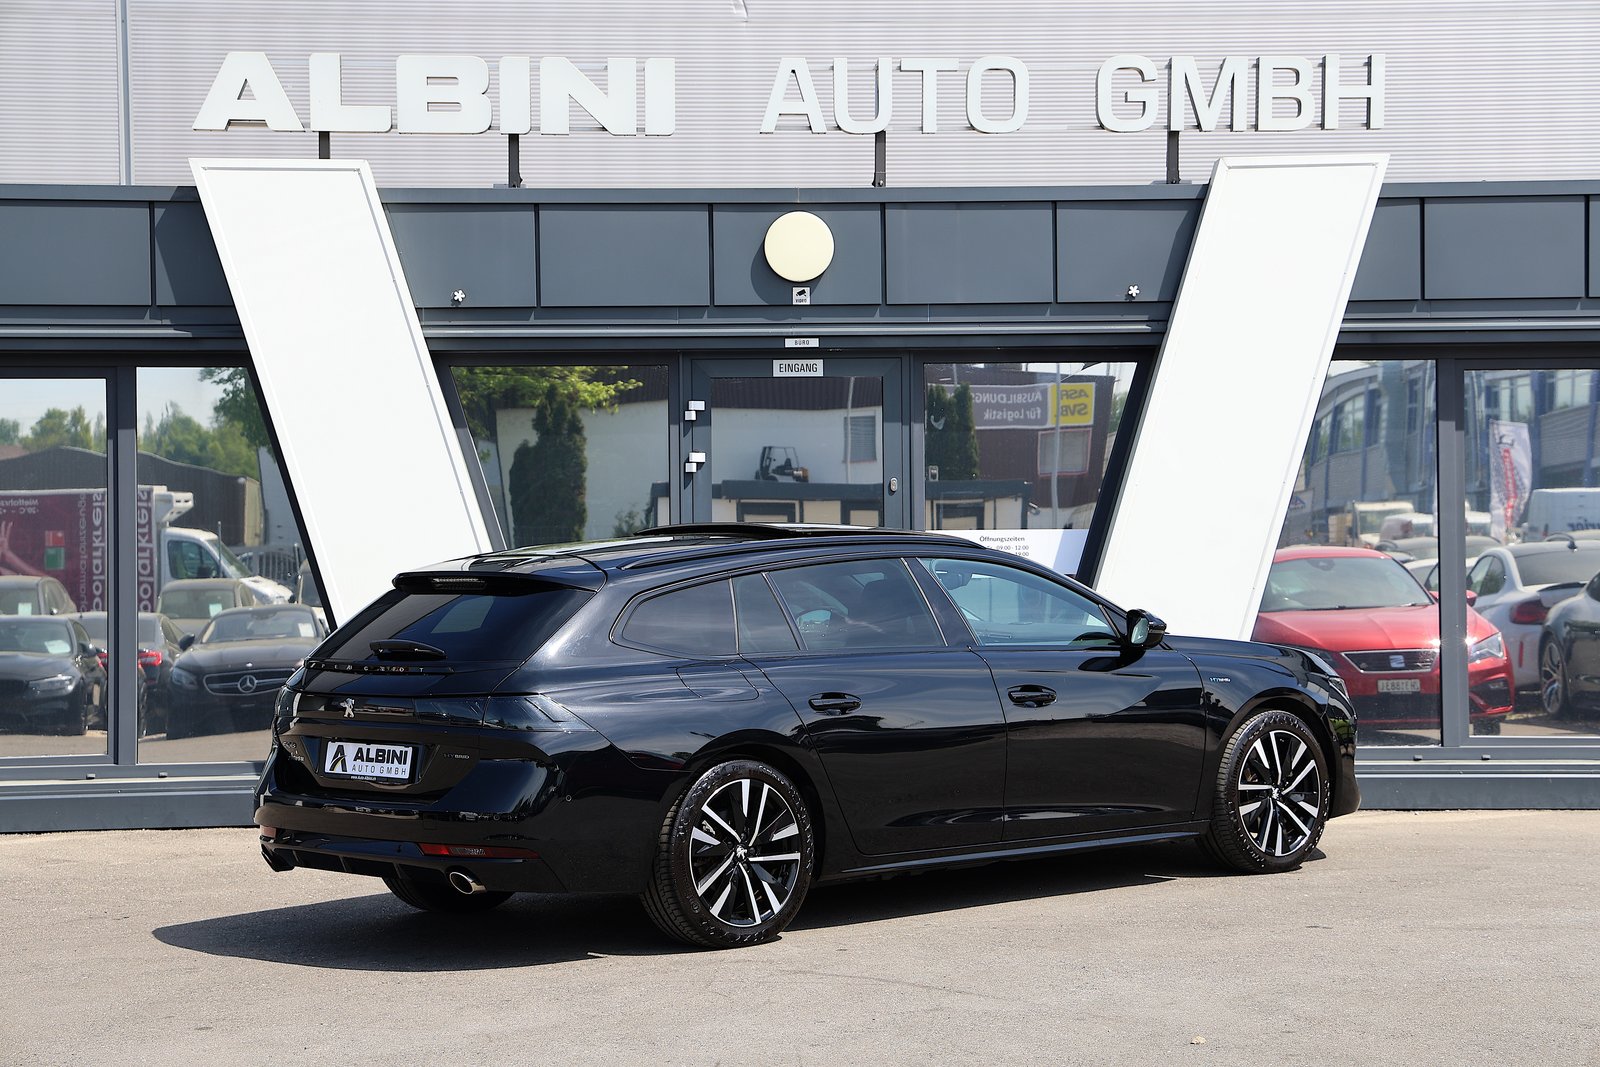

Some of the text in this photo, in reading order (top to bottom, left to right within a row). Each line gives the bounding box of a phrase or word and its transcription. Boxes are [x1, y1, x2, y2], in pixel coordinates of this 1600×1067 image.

[192, 52, 1386, 136] ALBINI AUTO GMBH
[779, 363, 818, 373] EINGANG
[979, 535, 1025, 543] Öffnungszeiten
[353, 747, 409, 765] ALBINI
[352, 764, 407, 775] AUTO GMBH
